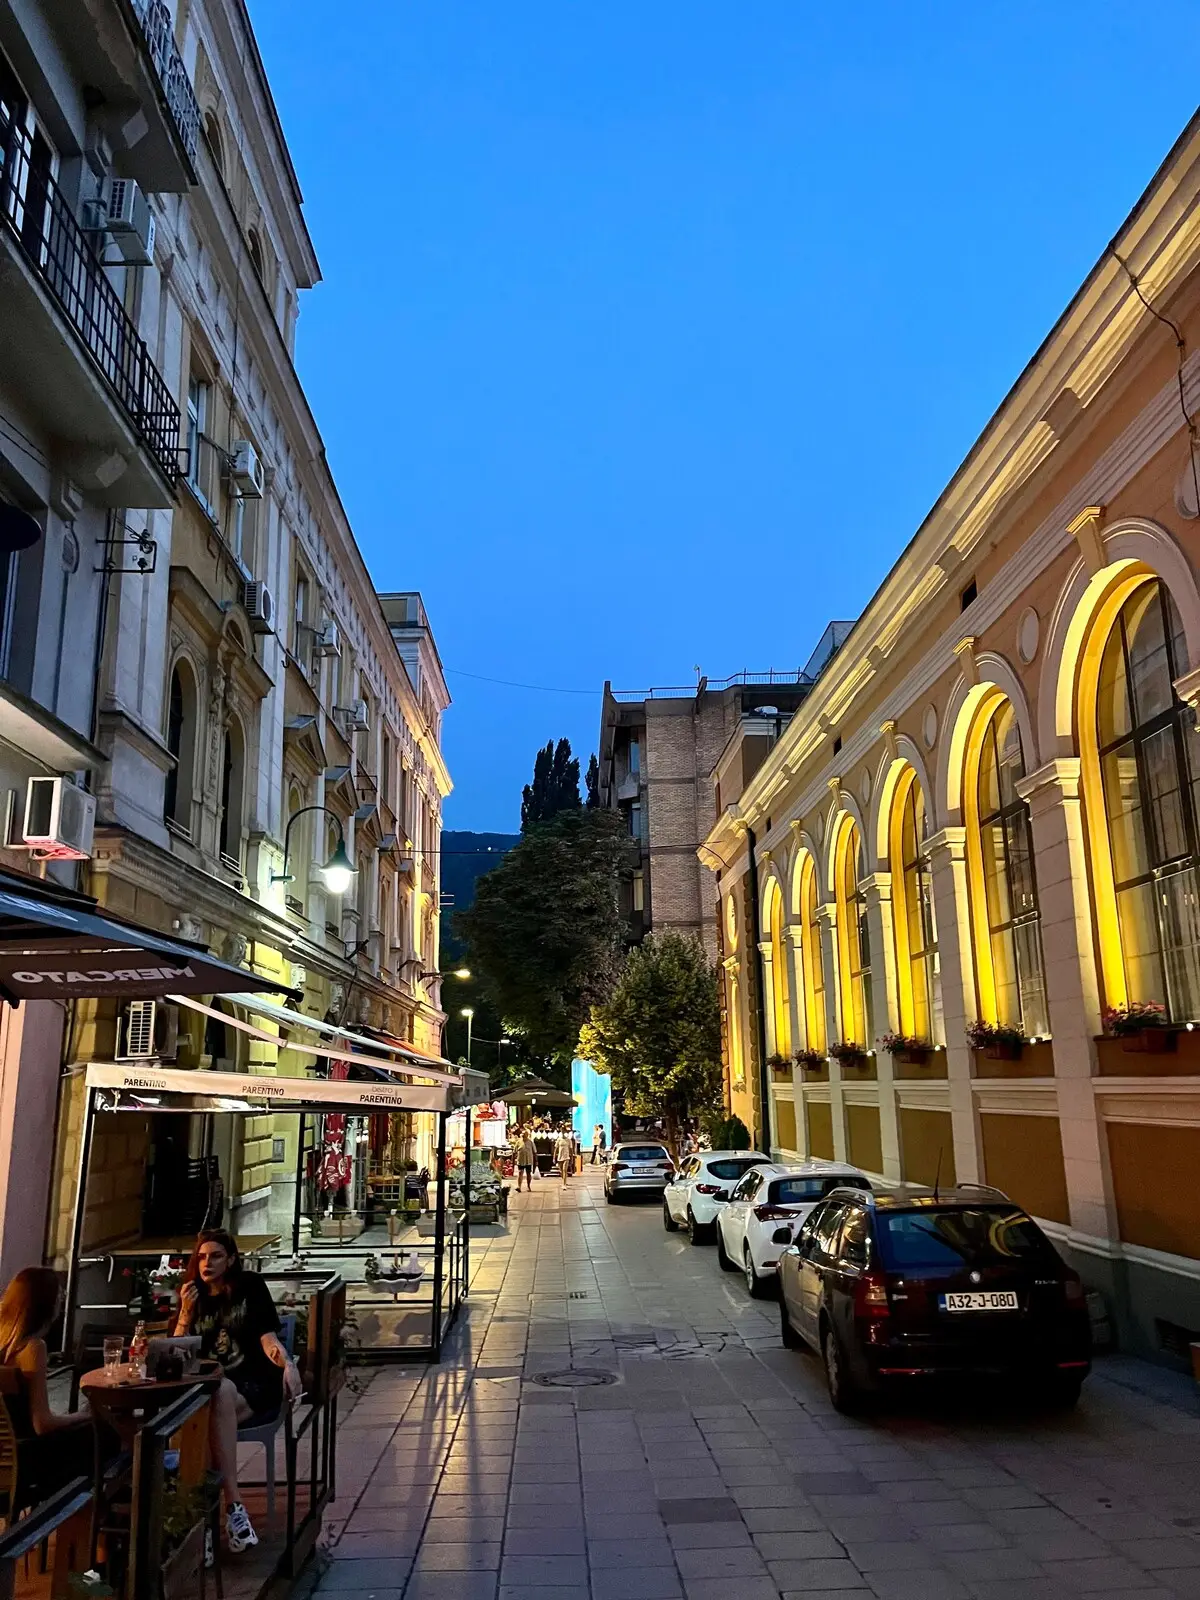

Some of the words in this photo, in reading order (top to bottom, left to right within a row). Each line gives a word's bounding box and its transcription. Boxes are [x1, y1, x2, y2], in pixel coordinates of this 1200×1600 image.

[124, 1078, 167, 1089] PARENTINO
[242, 1086, 285, 1096] PARENTINO
[360, 1094, 402, 1105] PARENTINO
[948, 1293, 1015, 1309] A32-J-080
